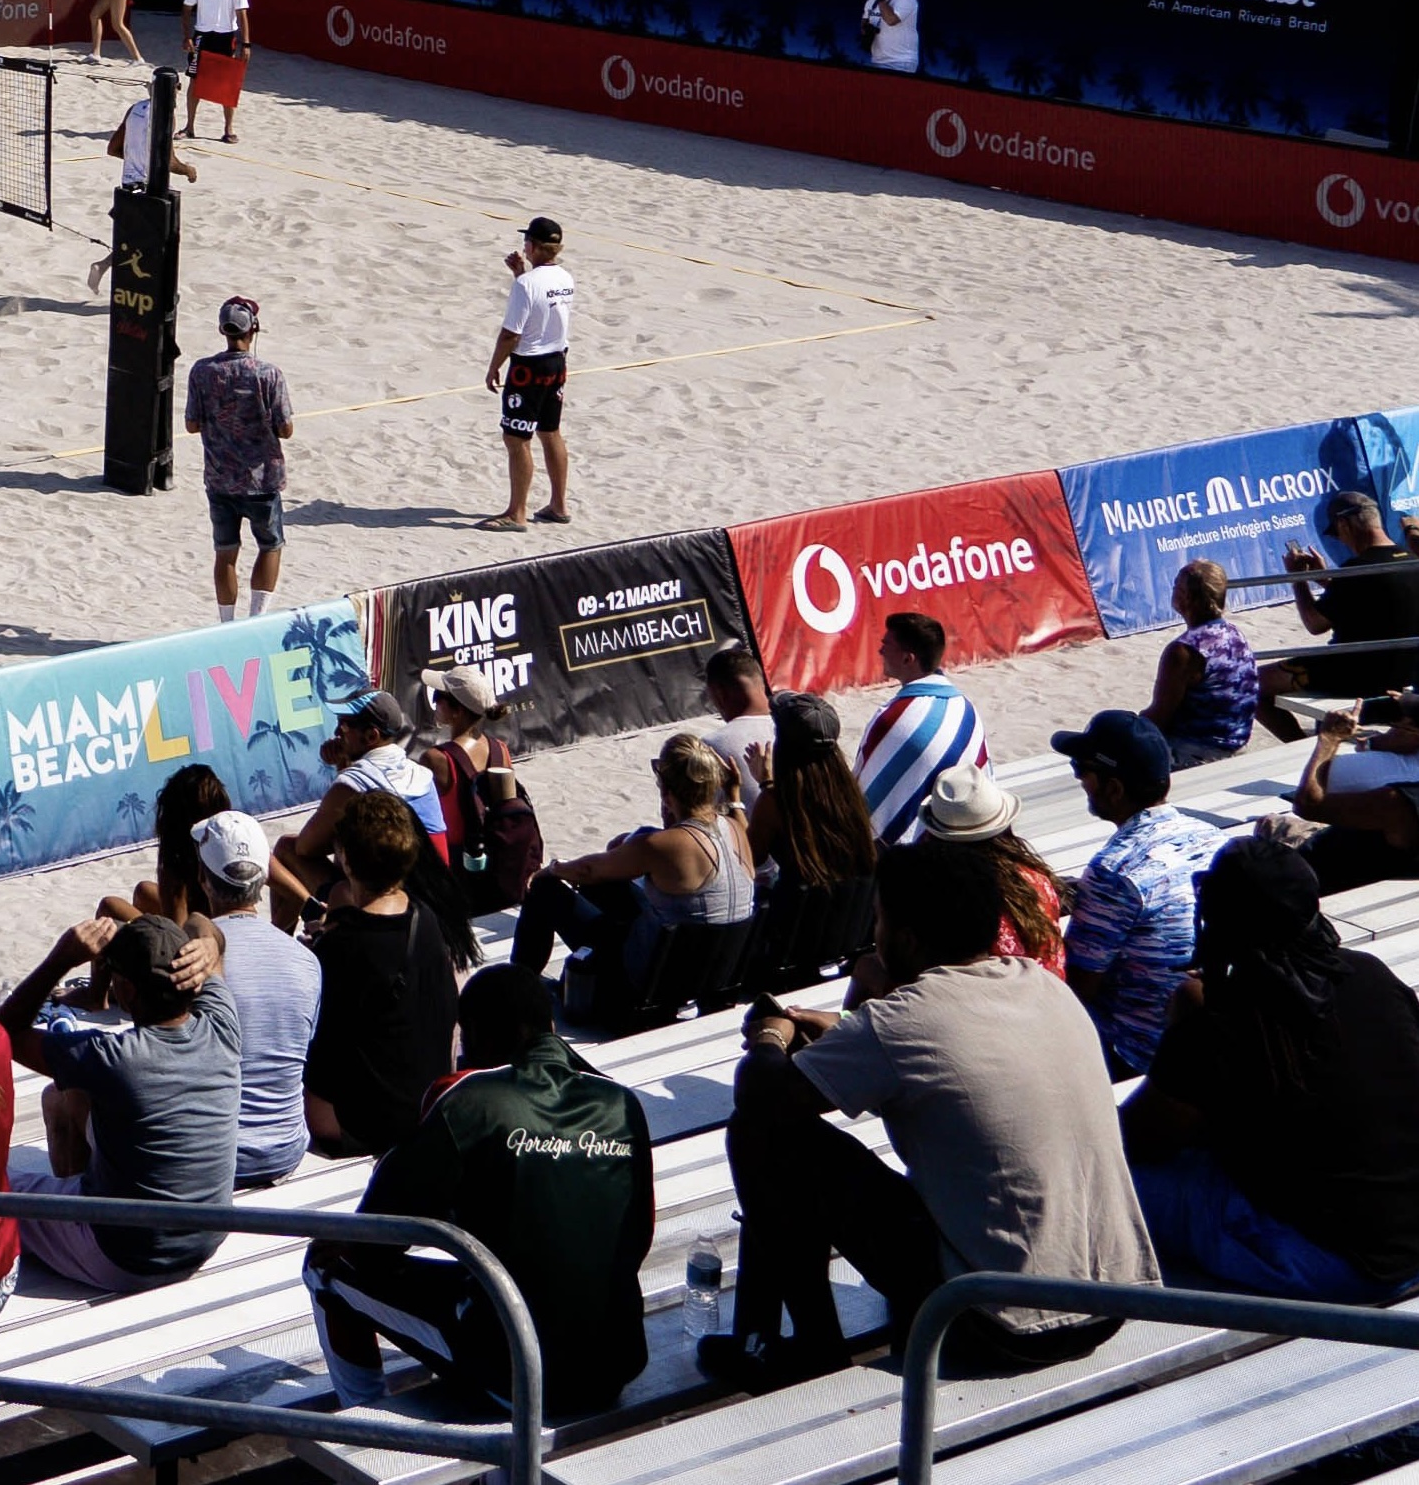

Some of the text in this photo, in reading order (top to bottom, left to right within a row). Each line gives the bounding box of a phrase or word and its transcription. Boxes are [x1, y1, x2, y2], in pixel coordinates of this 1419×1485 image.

[1171, 0, 1232, 21] American
[1236, 8, 1282, 28] Riveria
[1288, 16, 1328, 33] Brand
[360, 22, 447, 55] vodafone
[642, 73, 744, 108] vodafone
[974, 128, 1096, 171] vodafone
[113, 288, 154, 315] avp
[1101, 490, 1199, 536] MAURICE
[1241, 466, 1341, 511] LACROIX
[1156, 512, 1306, 554] Manufacture Horlogère Suisse
[861, 536, 1036, 600] vodafone
[577, 595, 598, 617] 09
[607, 590, 625, 611] 12
[626, 579, 681, 607] MARCH
[425, 593, 517, 652] KING
[573, 612, 703, 659] MIAMIBEACH
[454, 642, 495, 665] OF THE
[6, 679, 157, 758] MIAMI
[137, 646, 324, 764] LIVE
[11, 727, 140, 793] BEACH
[506, 1127, 573, 1160] Foreign
